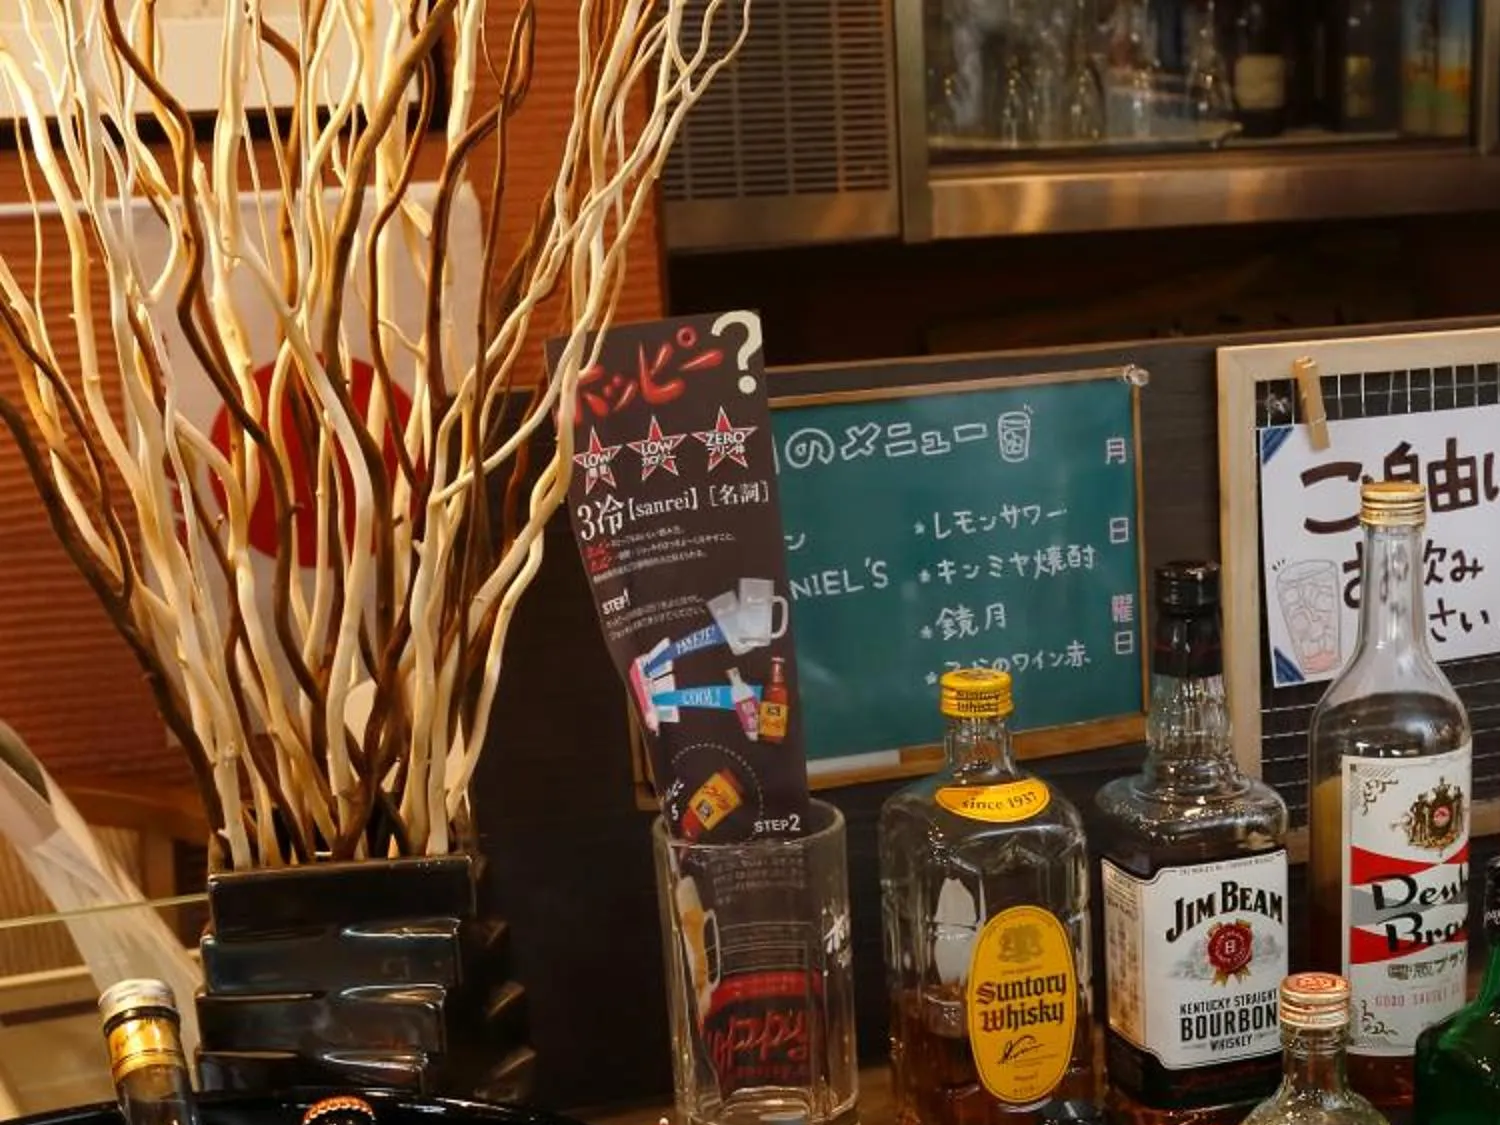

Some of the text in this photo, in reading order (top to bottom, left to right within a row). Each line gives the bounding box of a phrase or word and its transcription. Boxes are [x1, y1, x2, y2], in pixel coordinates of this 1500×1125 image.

[641, 440, 674, 455] LOW
[705, 431, 746, 446] ZERO
[772, 422, 988, 474] のメニュー
[1106, 438, 1126, 465] 月
[582, 453, 613, 469] LOW
[933, 504, 1067, 540] レモンサワー
[1110, 517, 1129, 543] 日
[788, 559, 889, 601] NIEL'S
[936, 544, 1096, 587] キンミヤ焼酎
[934, 602, 1007, 642] 鏡月
[754, 814, 801, 833] STEP2
[1165, 880, 1283, 942] JIM BEAM
[1377, 911, 1467, 953] Bra
[975, 973, 1067, 1005] Suntory
[1180, 988, 1278, 1016] KENTUCKY STRAIGHT
[980, 1000, 1066, 1033] Whisky
[1180, 1003, 1279, 1042] BOURBON
[1210, 1034, 1254, 1052] WHISKEY
